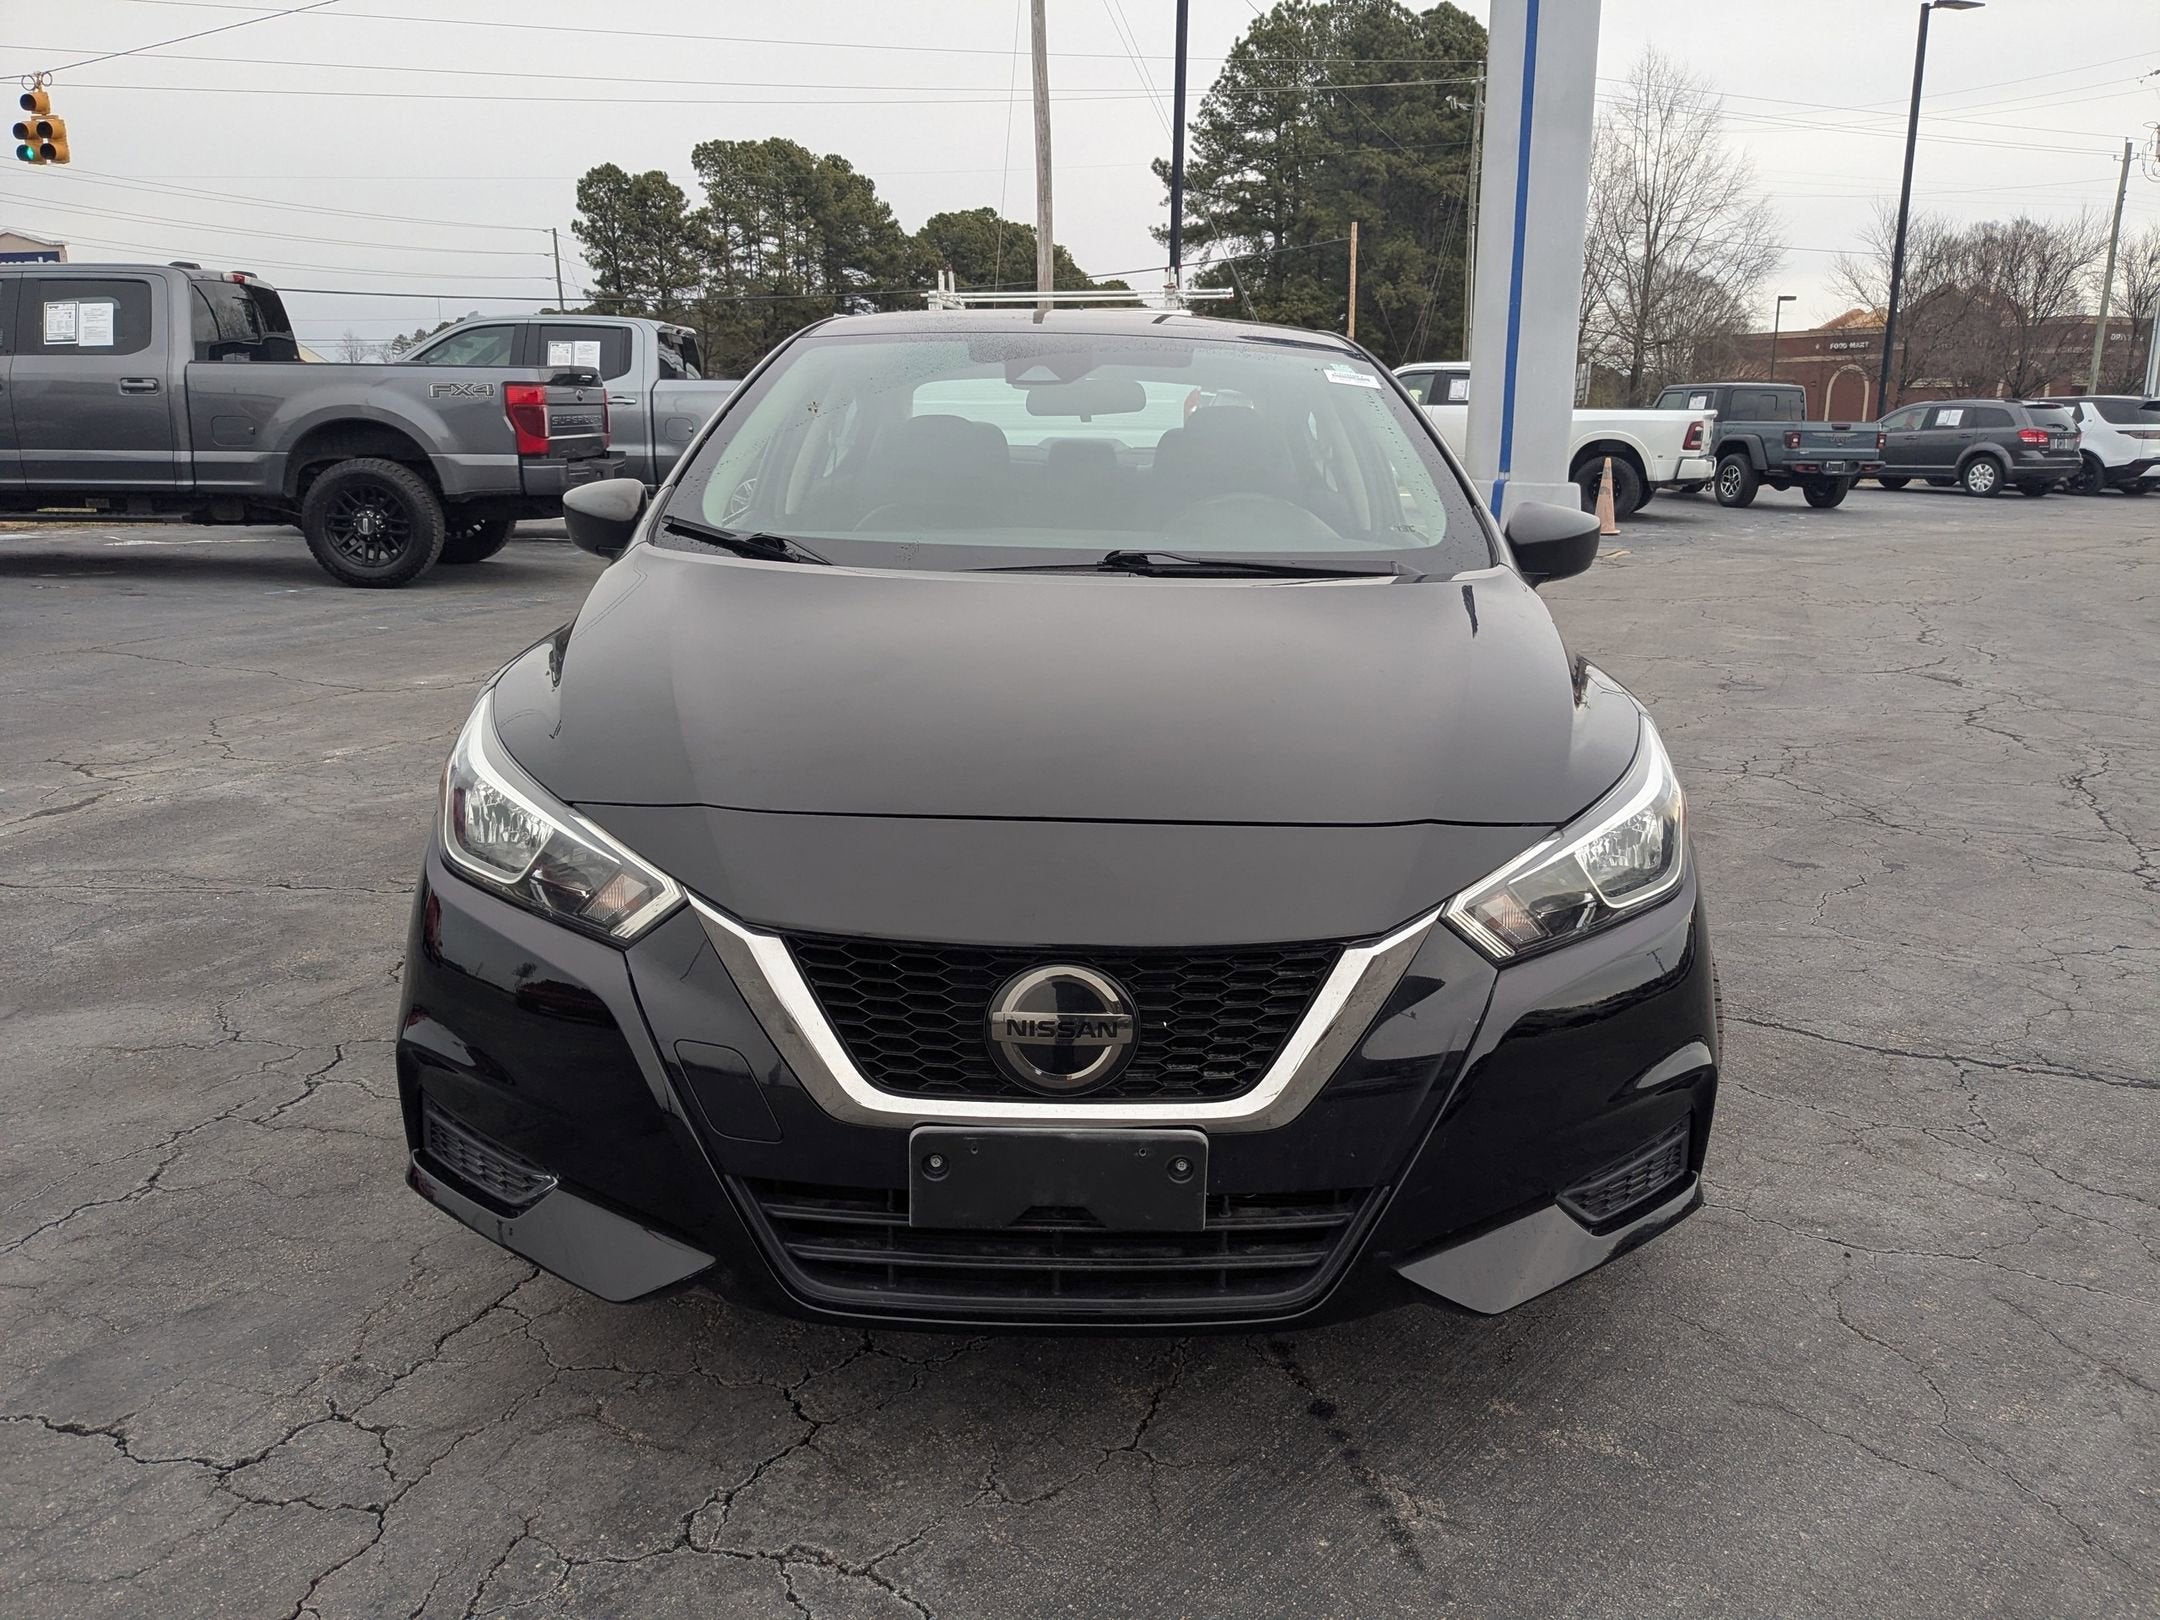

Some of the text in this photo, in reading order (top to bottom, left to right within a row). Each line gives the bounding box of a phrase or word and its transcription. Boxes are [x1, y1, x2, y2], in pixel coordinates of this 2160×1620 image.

[1830, 341, 1870, 350] FOOD MART
[429, 383, 495, 399] FX4
[1006, 1018, 1118, 1039] NISSAN
